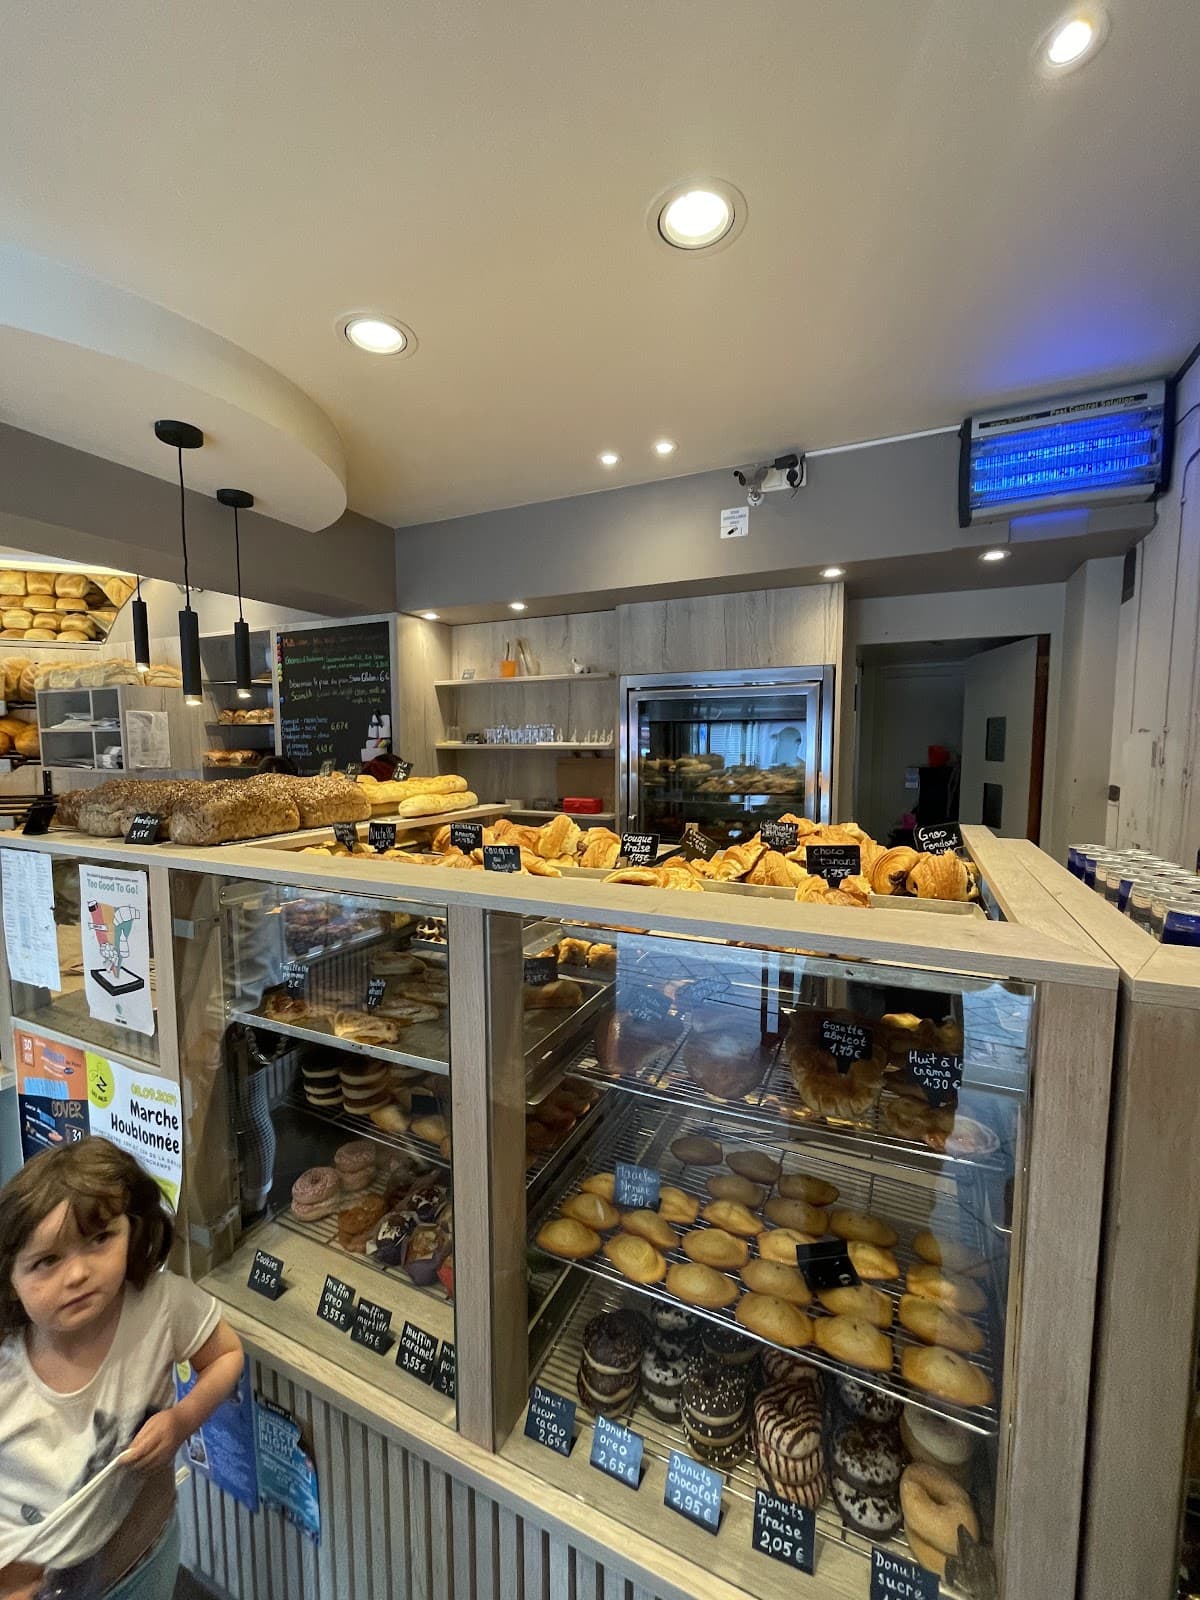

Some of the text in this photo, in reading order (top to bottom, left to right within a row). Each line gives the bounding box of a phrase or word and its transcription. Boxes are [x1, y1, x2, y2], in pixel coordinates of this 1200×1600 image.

[623, 834, 653, 846] Couque
[624, 842, 651, 853] fraise
[87, 879, 139, 895] Too Good To Go!
[823, 1031, 867, 1047] abricot
[909, 1050, 936, 1066] Huit
[51, 1101, 84, 1119] COVER
[130, 1098, 179, 1130] Marche
[110, 1112, 180, 1155] Houblonnée
[326, 1278, 350, 1299] muffin
[325, 1292, 343, 1308] oreo
[322, 1304, 346, 1325] 3,55€
[359, 1303, 385, 1320] muffin
[401, 1336, 435, 1361] caramel
[402, 1352, 427, 1374] 3,55€
[535, 1417, 566, 1437] cacao
[598, 1415, 633, 1443] Donuts
[599, 1434, 628, 1456] oreo
[673, 1455, 712, 1486] Donuts
[668, 1471, 719, 1505] chocolat
[757, 1490, 804, 1521] Donuts
[758, 1507, 803, 1540] fraise
